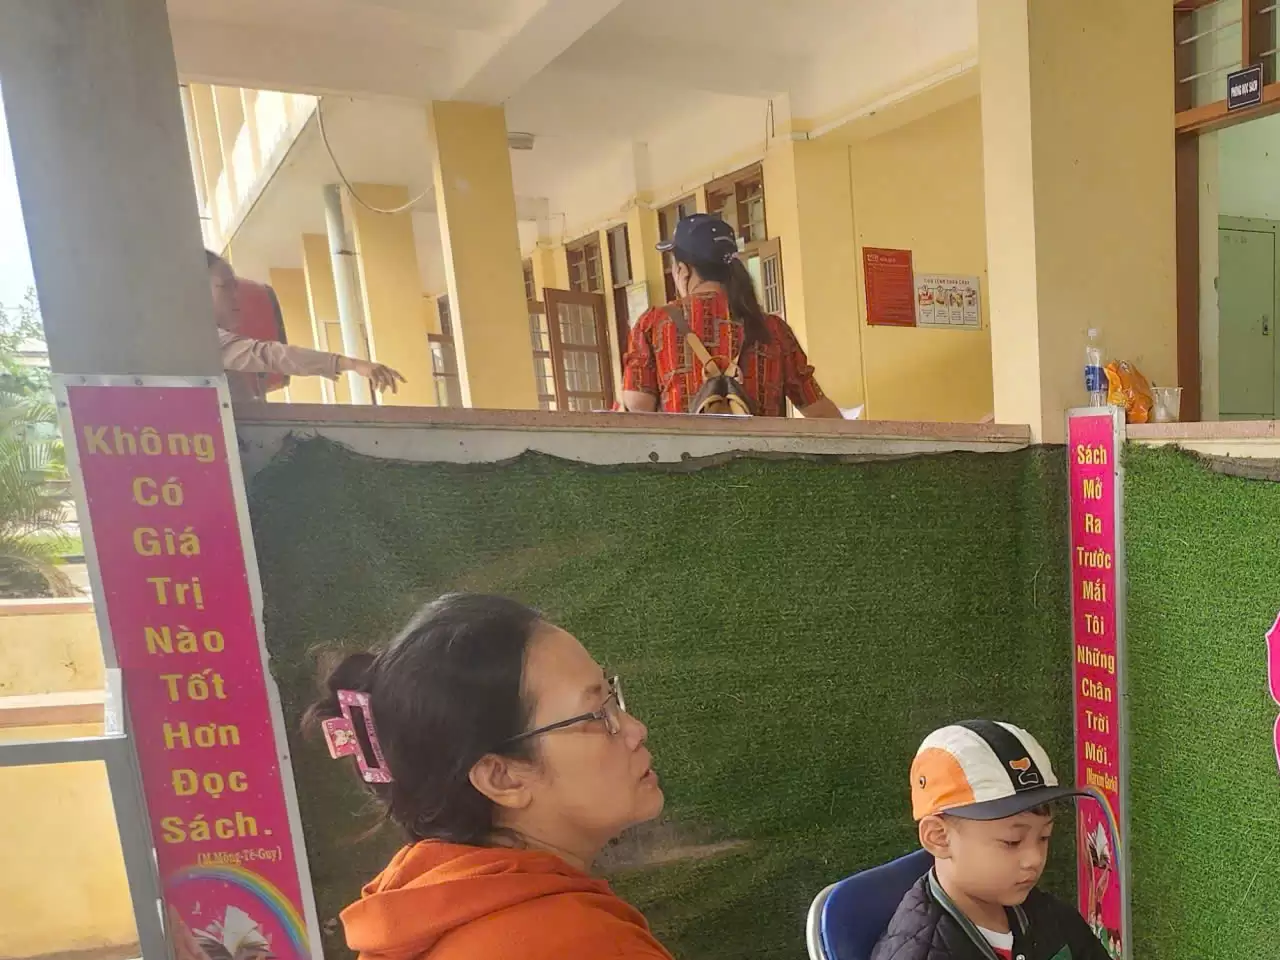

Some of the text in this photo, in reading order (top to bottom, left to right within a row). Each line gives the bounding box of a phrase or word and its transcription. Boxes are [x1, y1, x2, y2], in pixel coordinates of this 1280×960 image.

[83, 425, 216, 463] Không
[1077, 444, 1108, 465] Sách
[132, 476, 184, 506] Có
[1083, 476, 1103, 500] Mở
[1085, 513, 1102, 533] Ra
[133, 526, 201, 557] Giá
[1076, 546, 1112, 569] Trước
[146, 576, 205, 610] Trị
[1082, 578, 1107, 603] Mắt
[1085, 614, 1105, 635] Tôi
[144, 625, 225, 654] Nào
[1077, 644, 1115, 674] Những
[159, 668, 228, 702] Tốt
[1081, 677, 1112, 703] Chân
[162, 721, 241, 750] Hơn
[1085, 710, 1110, 735] Trời
[1085, 741, 1112, 767] Mới.
[171, 768, 249, 799] Đọc
[160, 811, 273, 844] Sách.
